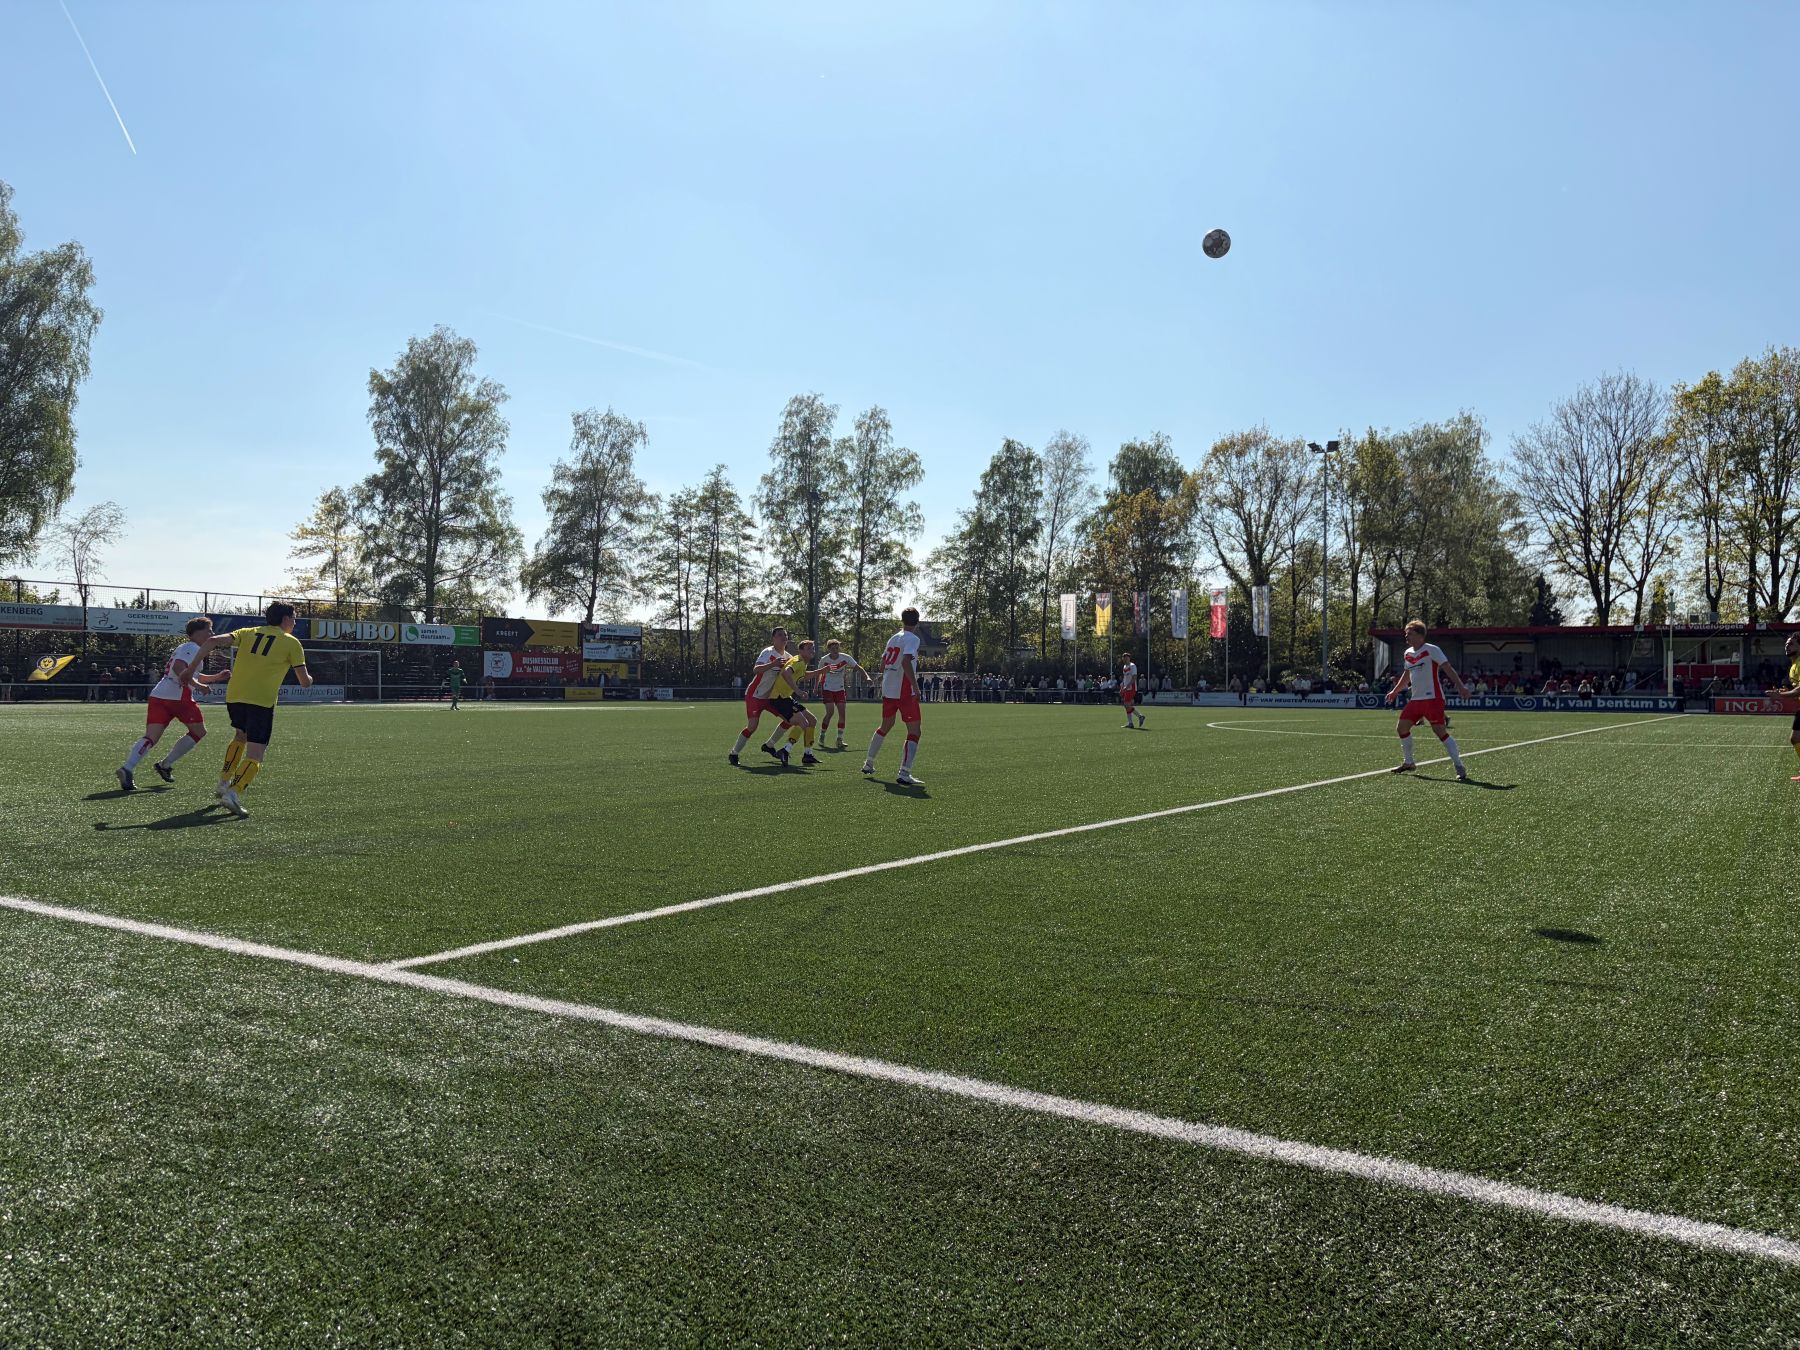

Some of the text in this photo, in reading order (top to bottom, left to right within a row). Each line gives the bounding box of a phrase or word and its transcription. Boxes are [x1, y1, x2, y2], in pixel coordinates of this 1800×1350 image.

[315, 620, 396, 641] JUMBO
[250, 632, 276, 656] 11
[1484, 696, 1501, 707] bv
[1568, 698, 1593, 707] van
[1596, 697, 1654, 709] bentum
[1658, 697, 1677, 709] bv
[1725, 701, 1758, 712] ING
